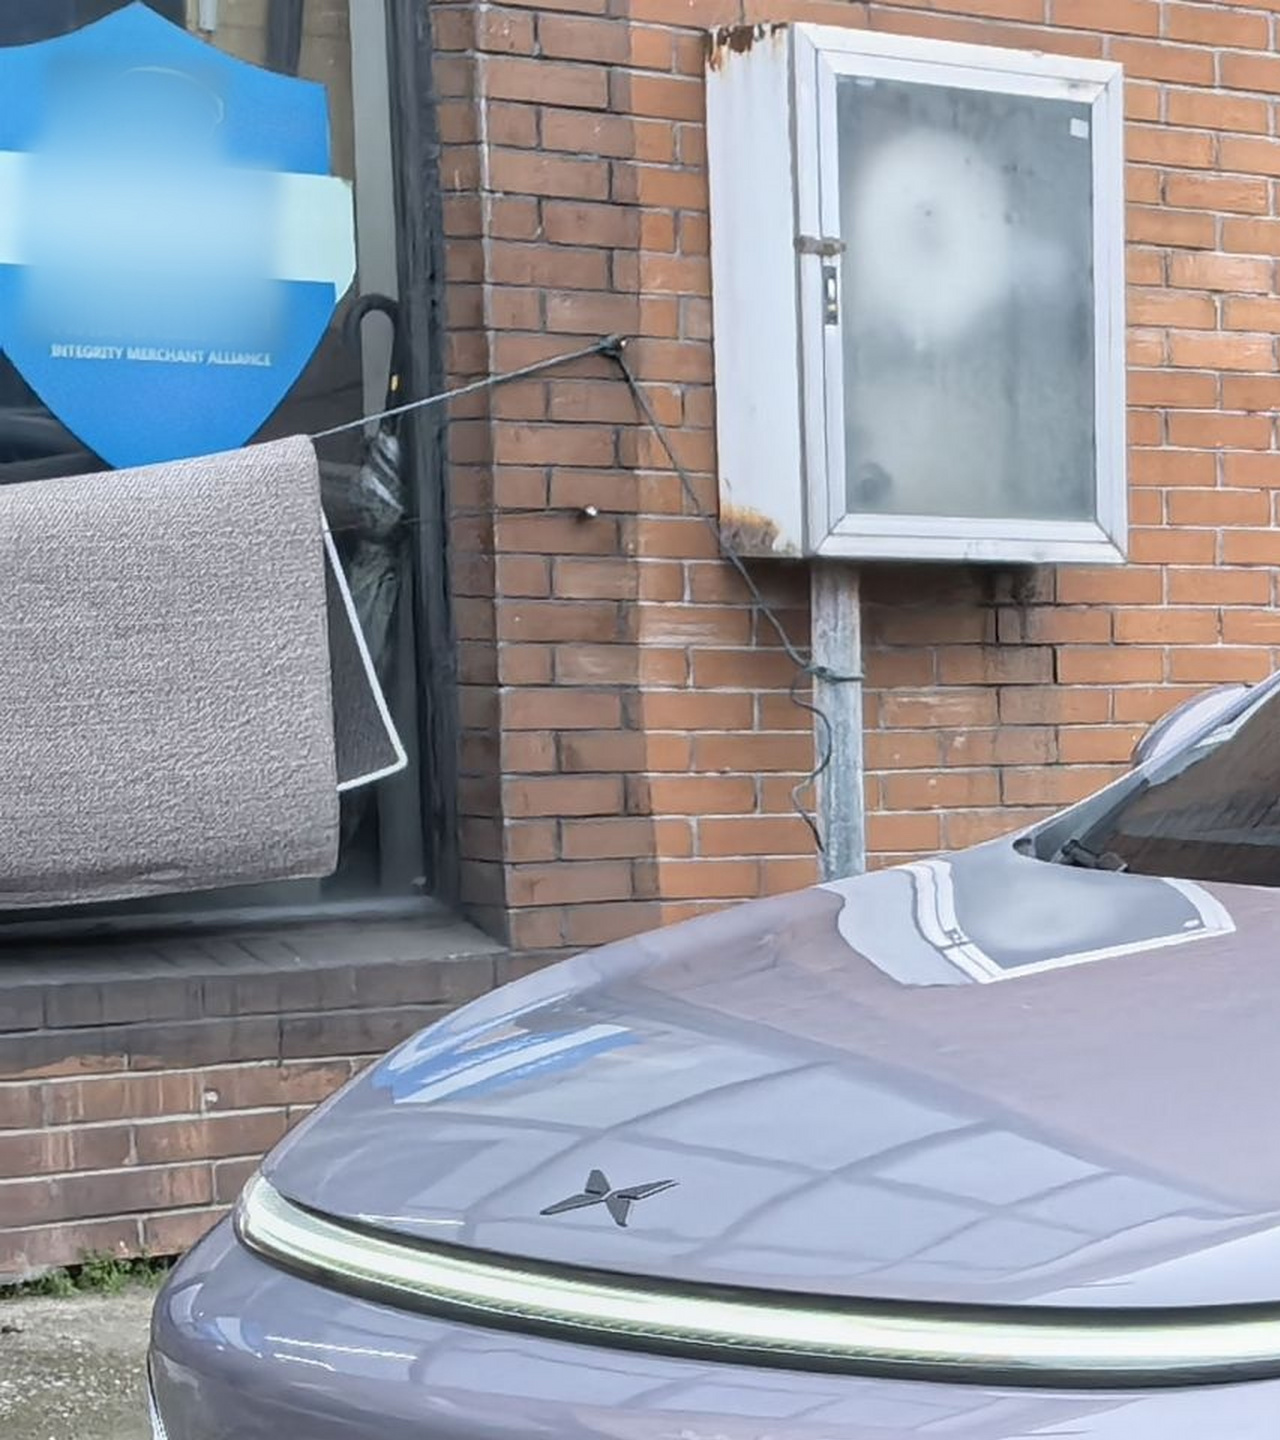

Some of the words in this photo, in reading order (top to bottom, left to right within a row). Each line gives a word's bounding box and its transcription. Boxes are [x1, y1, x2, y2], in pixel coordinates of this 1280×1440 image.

[51, 343, 123, 360] INTEGRITY
[126, 346, 204, 363] MERCHANT
[206, 351, 272, 367] ALLIANCE
